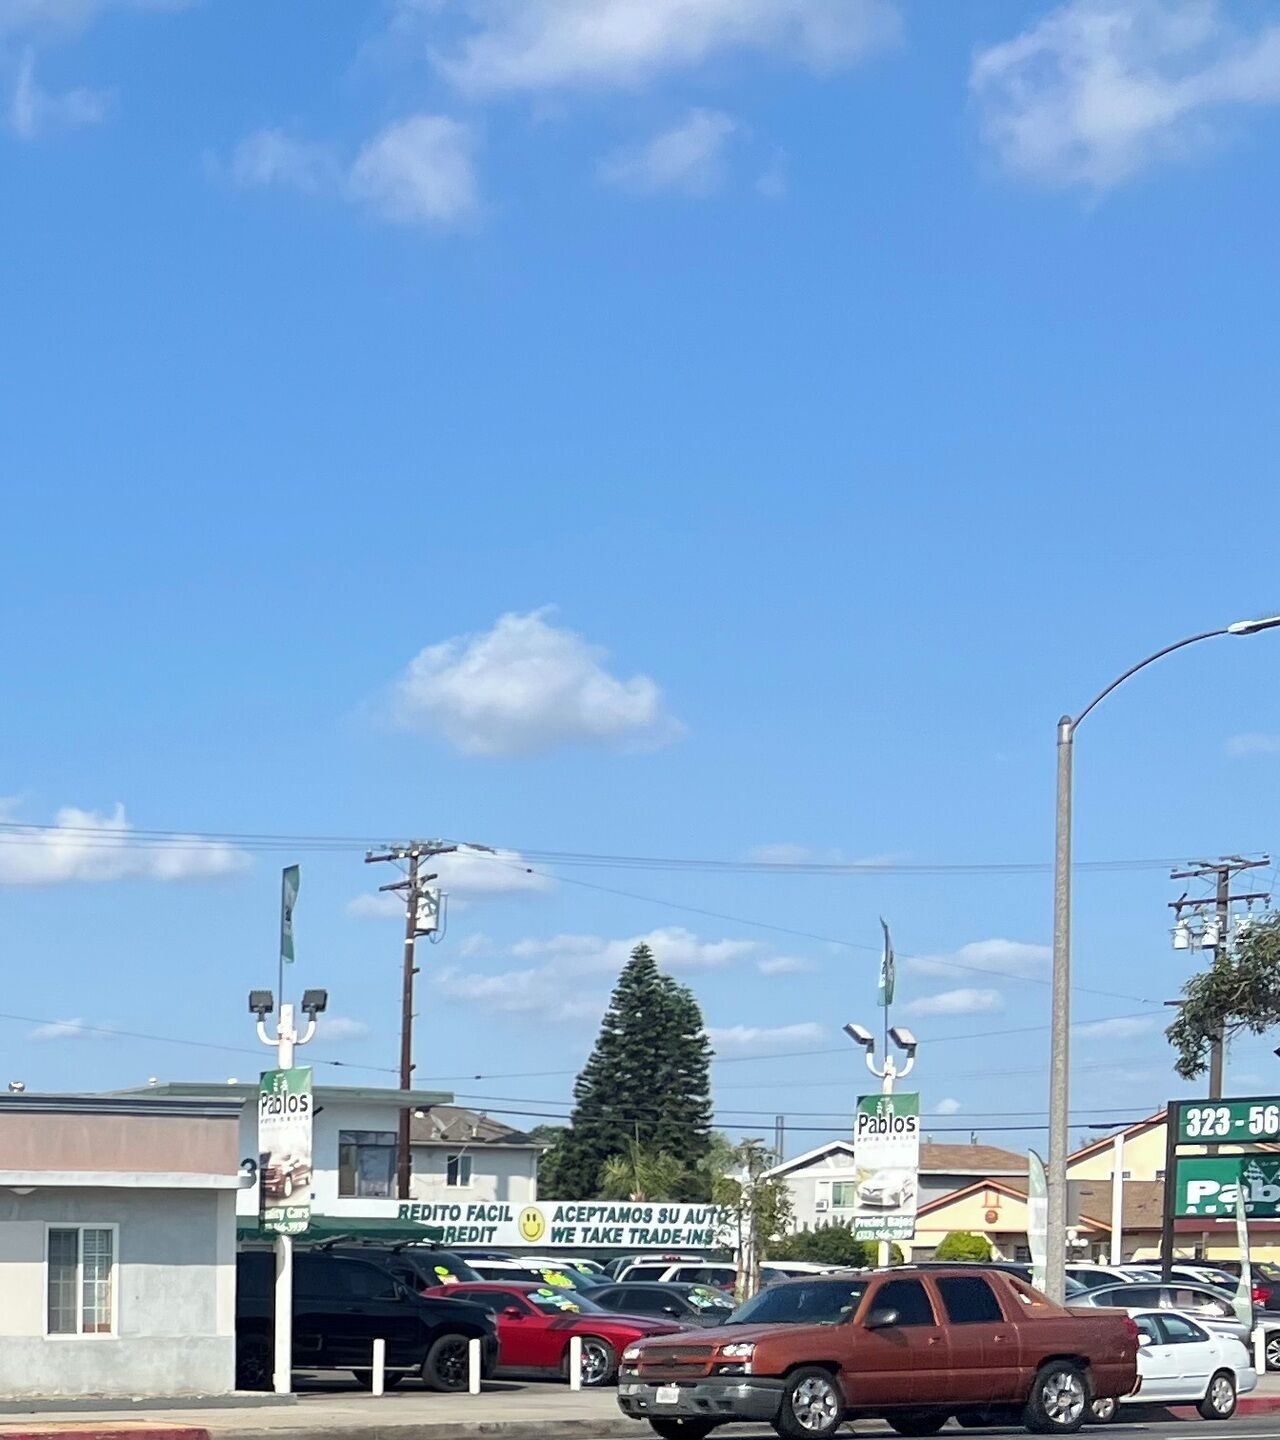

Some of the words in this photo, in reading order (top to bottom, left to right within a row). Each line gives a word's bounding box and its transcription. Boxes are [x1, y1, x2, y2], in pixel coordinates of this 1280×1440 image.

[260, 1091, 309, 1116] Pablos
[858, 1112, 916, 1136] Pablos
[466, 1204, 514, 1222] FACIL
[552, 1205, 654, 1224] ACEPTAMOS
[657, 1207, 680, 1224] SU
[550, 1226, 577, 1244] WE
[581, 1227, 624, 1244] TAKE
